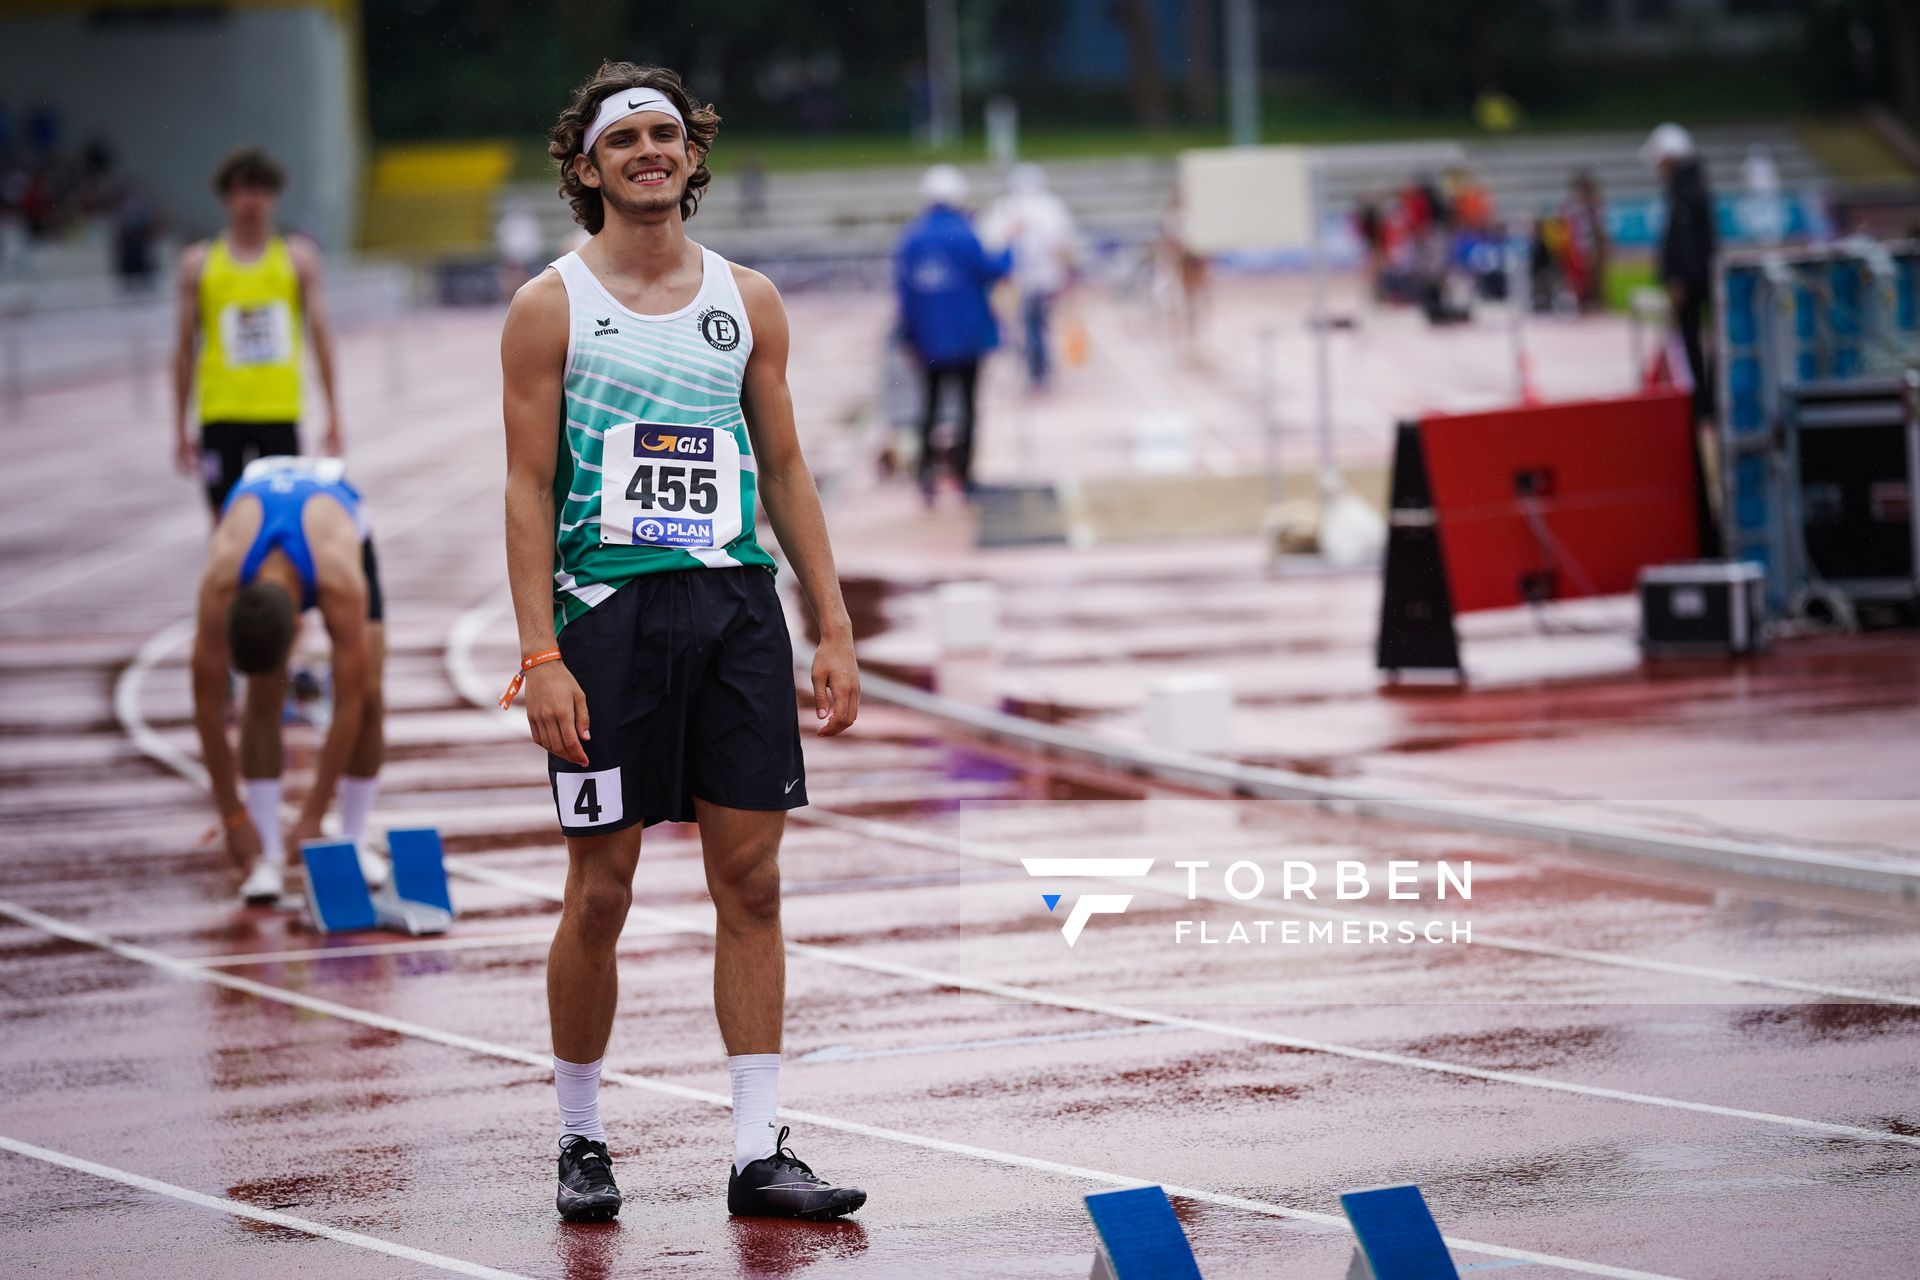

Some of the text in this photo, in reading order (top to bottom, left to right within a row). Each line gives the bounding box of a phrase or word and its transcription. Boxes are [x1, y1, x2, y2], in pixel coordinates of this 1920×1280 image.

[594, 328, 619, 337] erima
[712, 320, 731, 341] E
[677, 436, 708, 454] GLS
[625, 465, 718, 514] 455
[666, 522, 710, 537] PLAN
[574, 778, 603, 823] 4
